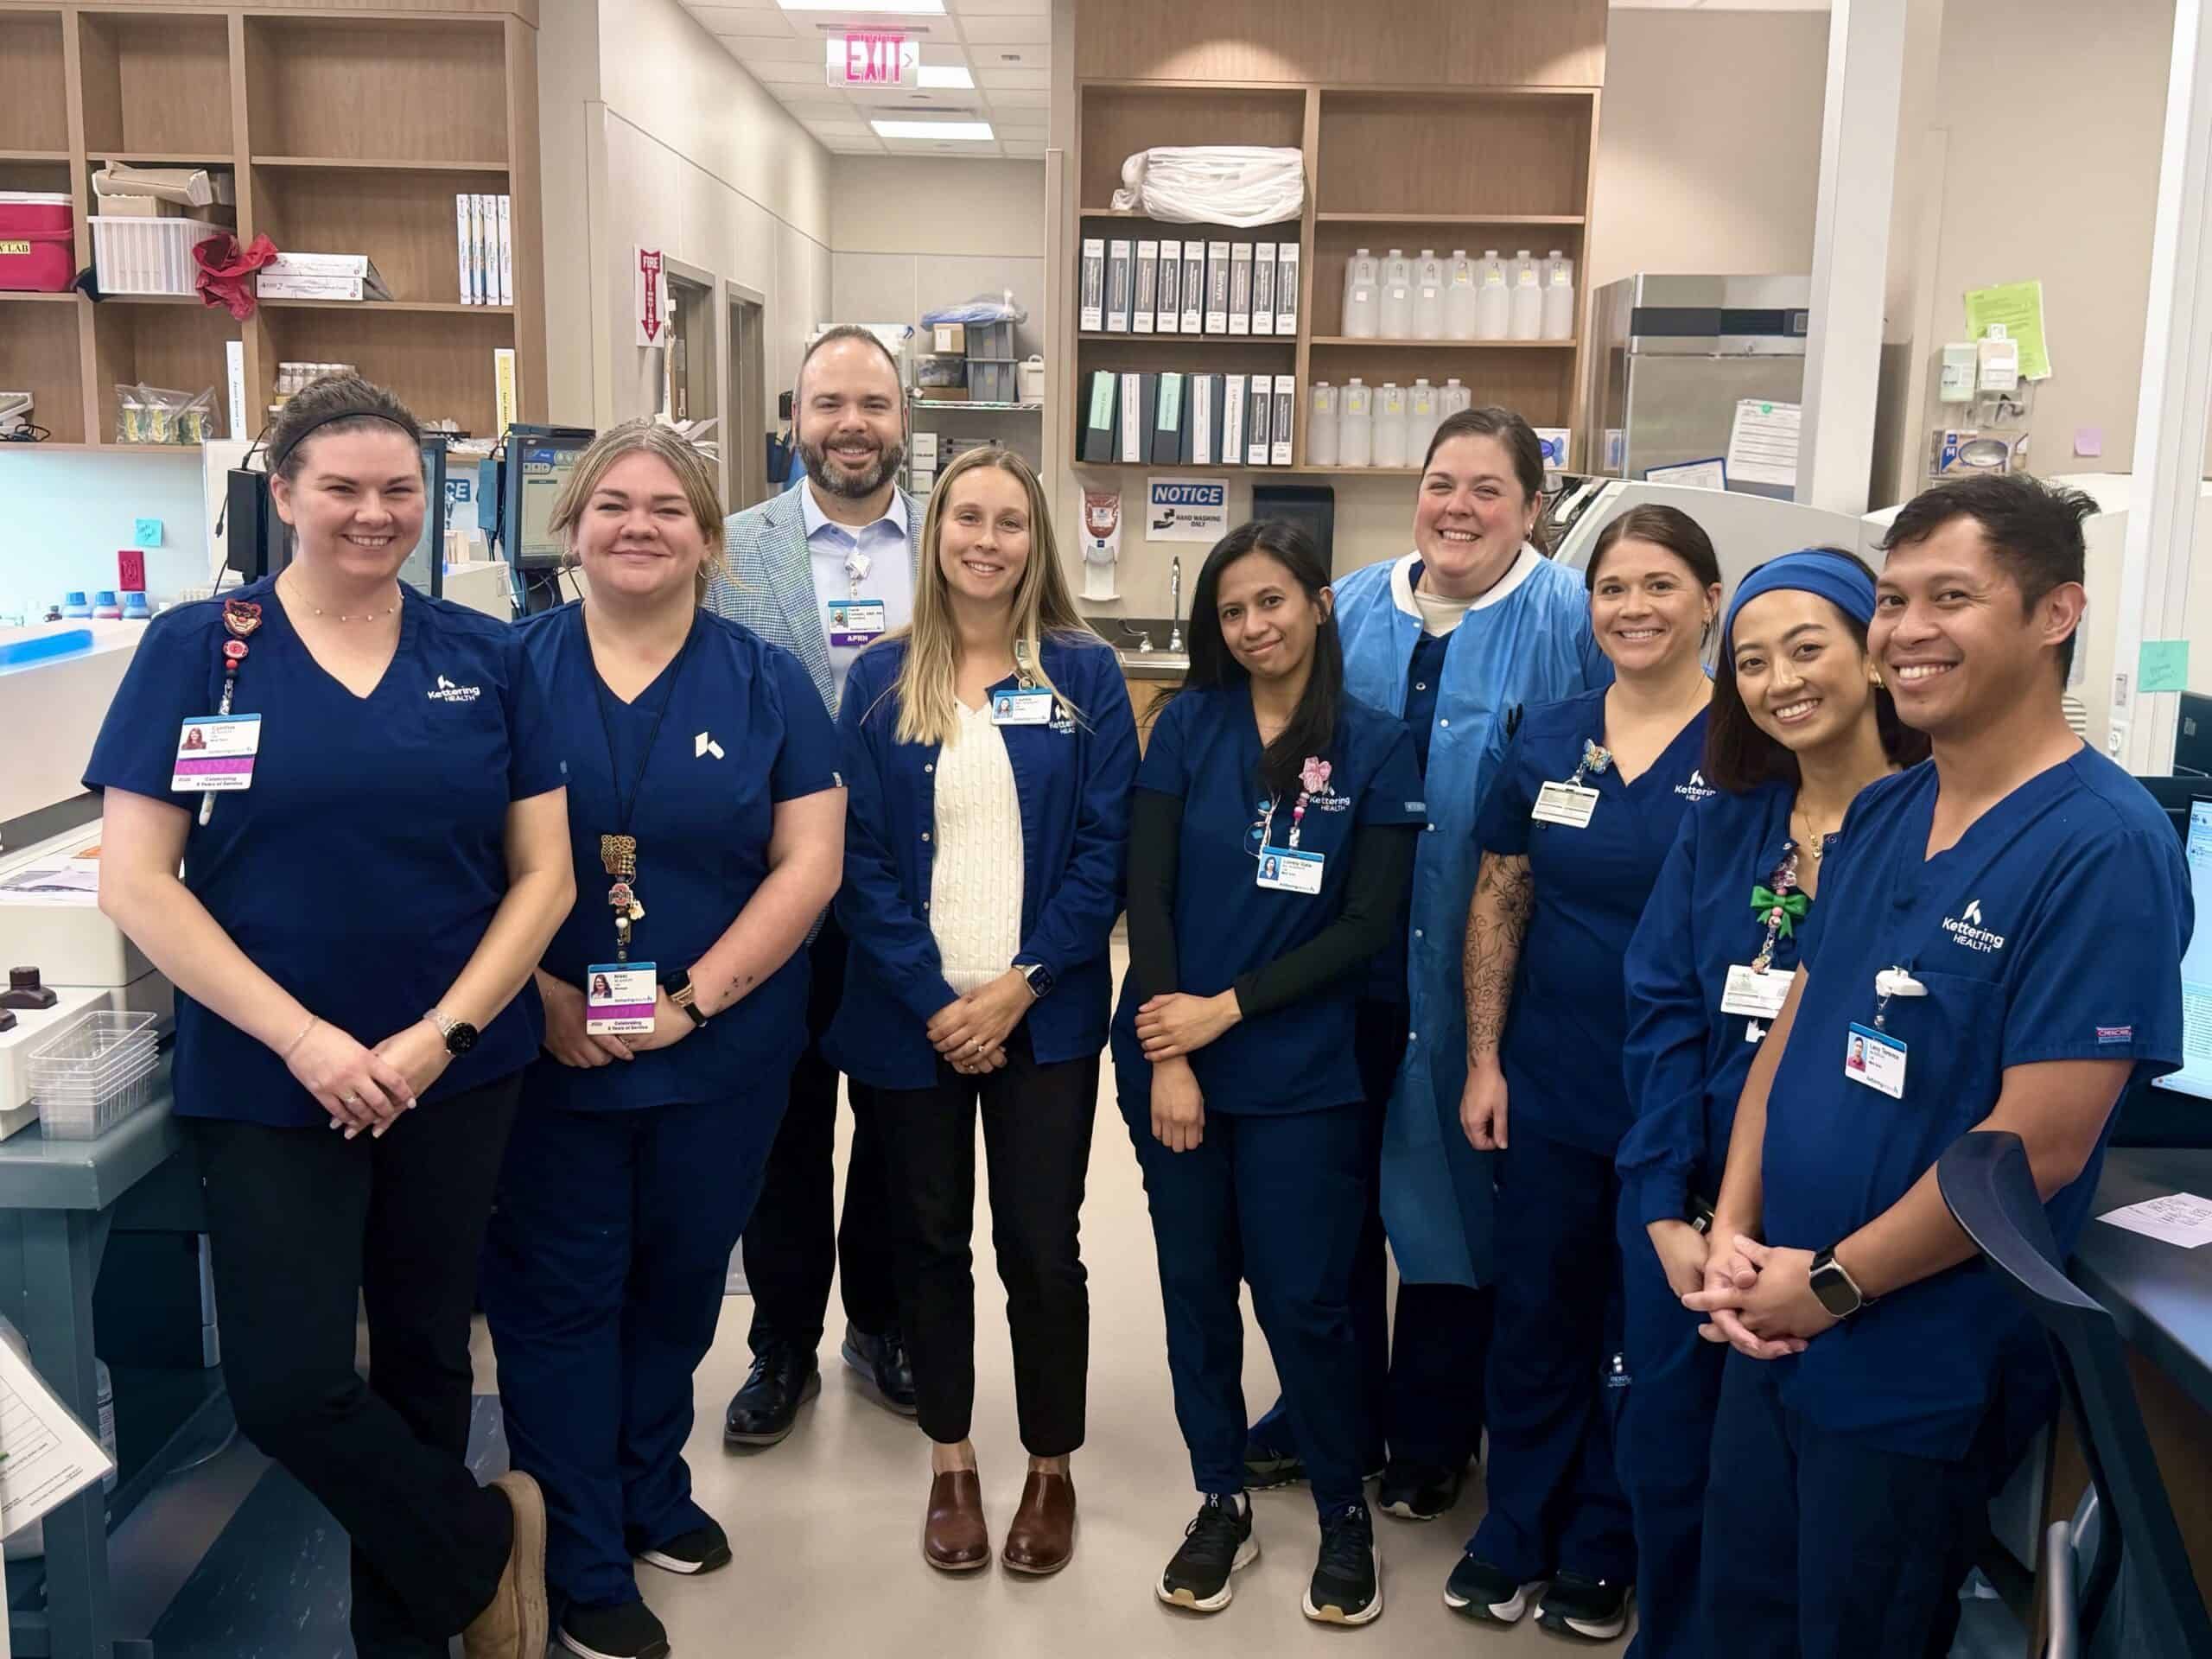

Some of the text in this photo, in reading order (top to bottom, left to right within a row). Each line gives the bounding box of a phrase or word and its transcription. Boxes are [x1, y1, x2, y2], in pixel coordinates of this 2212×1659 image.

[844, 35, 905, 82] EXIT
[8, 244, 29, 252] LAB
[642, 256, 658, 269] FIRE
[1154, 486, 1221, 503] NOTICE
[427, 686, 480, 698] Kettering
[1309, 796, 1351, 806] Kettering
[1942, 917, 2005, 948] Kettering
[1953, 933, 1992, 953] HEALTH
